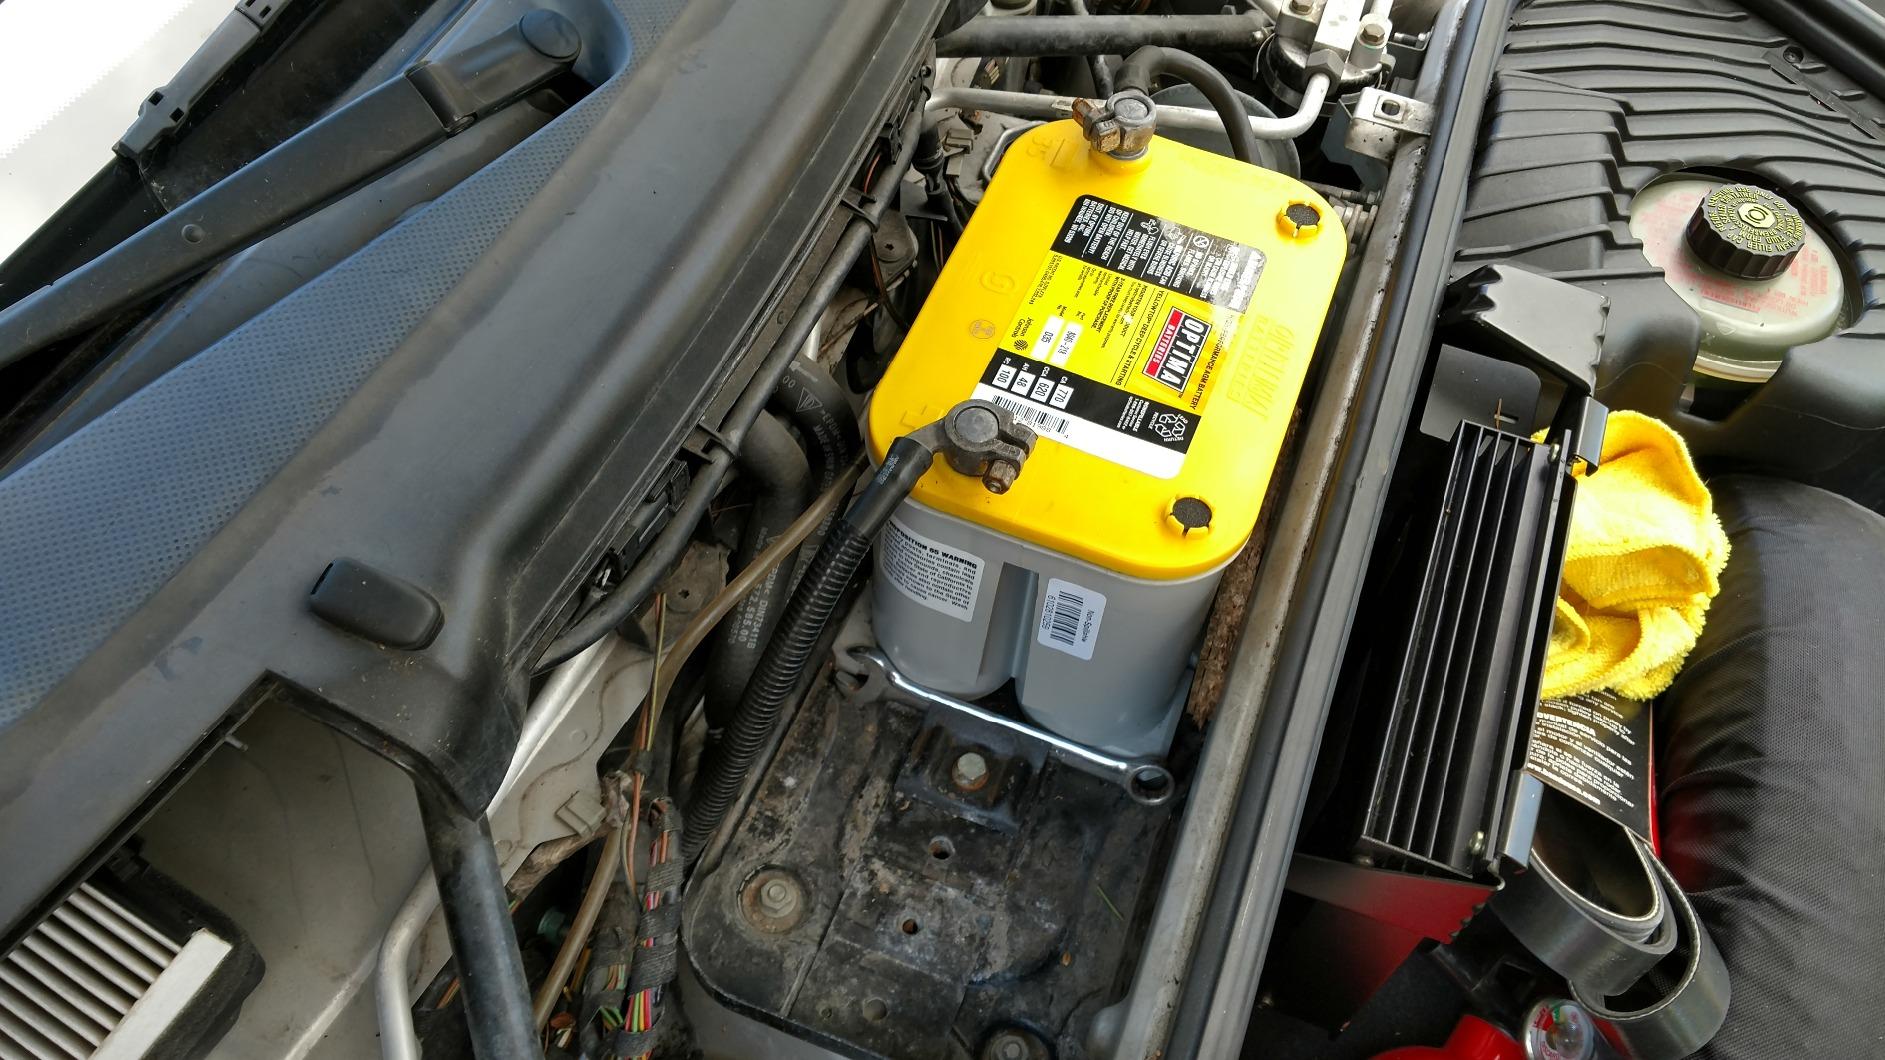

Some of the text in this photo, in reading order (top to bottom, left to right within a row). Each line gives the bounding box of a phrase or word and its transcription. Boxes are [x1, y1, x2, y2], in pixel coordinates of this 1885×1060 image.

[1754, 189, 1774, 201] ONLY
[1102, 212, 1113, 223] NOT
[1106, 206, 1116, 214] DO
[1114, 208, 1123, 216] OF
[1081, 219, 1096, 237] OPTIMA
[1096, 221, 1108, 234] OPEN
[1099, 210, 1130, 261] KEEP OUT OF THE REACH
[1727, 233, 1744, 245] CAP
[1738, 230, 1763, 243] FROM
[1747, 241, 1773, 253] FILLER
[1009, 317, 1026, 338] Controls
[1018, 317, 1034, 338] Johnson
[1119, 315, 1133, 337] ODUCT
[1136, 322, 1149, 338] DEEP
[1128, 336, 1142, 356] CYCLE
[1151, 323, 1176, 364] BATTERIES
[1159, 317, 1206, 386] OPTIMA
[996, 368, 1011, 384] 100
[1040, 365, 1050, 377] CCA
[1114, 358, 1132, 386] STARTING
[1199, 369, 1212, 384] AGM
[1015, 376, 1029, 388] 48
[1059, 375, 1068, 385] CA
[1034, 381, 1050, 397] 620
[1053, 387, 1069, 404] 770
[1188, 382, 1206, 411] BATTERY
[1147, 411, 1159, 430] RECYCLE
[941, 552, 978, 569] WARNING
[917, 571, 929, 579] and
[936, 562, 960, 574] contain
[961, 571, 975, 580] lead
[963, 567, 976, 575] and
[936, 574, 965, 587] California
[945, 593, 962, 602] State
[951, 601, 968, 610] Wash
[746, 600, 769, 649] DIN73411B
